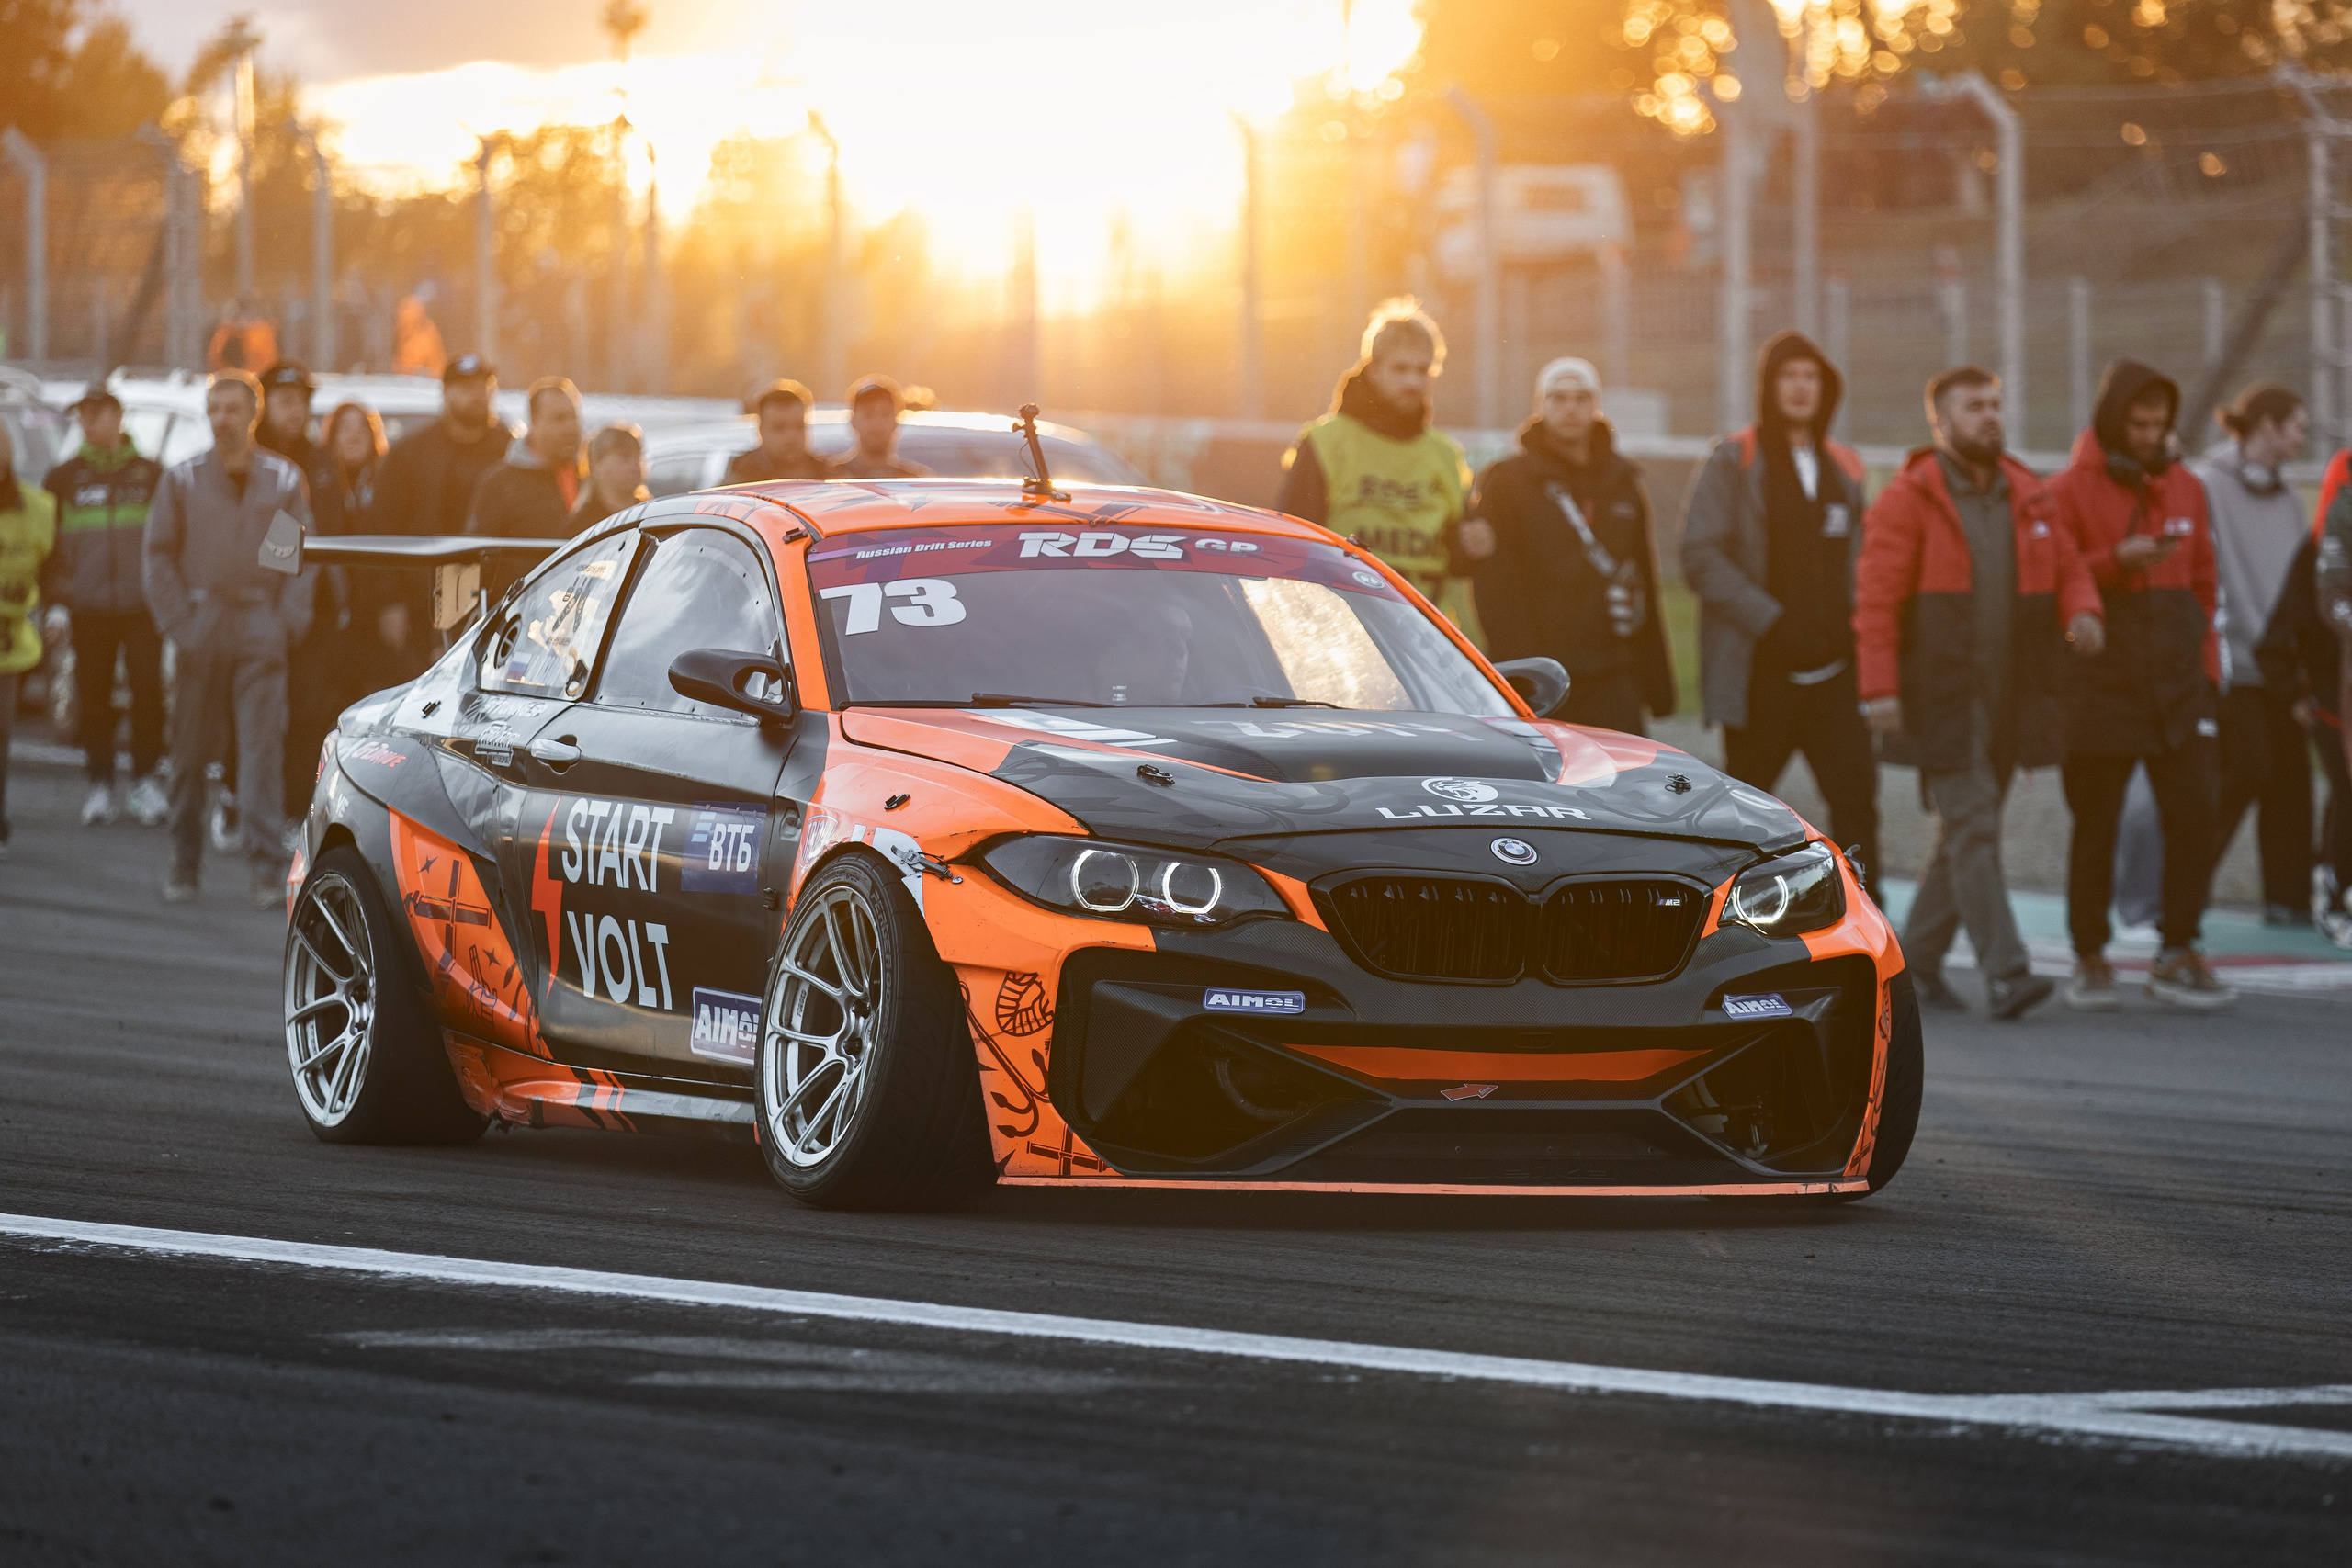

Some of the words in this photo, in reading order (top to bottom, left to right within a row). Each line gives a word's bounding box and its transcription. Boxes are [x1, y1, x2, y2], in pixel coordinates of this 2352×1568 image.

[856, 547, 912, 559] Russian
[914, 542, 945, 552] Drift
[947, 539, 992, 549] Series
[1018, 532, 1188, 559] RDS
[1194, 538, 1264, 557] GP
[819, 578, 967, 636] 73
[1374, 804, 1592, 820] LUZAR
[561, 797, 675, 893] START
[708, 823, 756, 873] ВТБ
[566, 910, 673, 1010] VOLT
[1207, 993, 1299, 1010] AIMOL
[1724, 998, 1790, 1014] AIMOL
